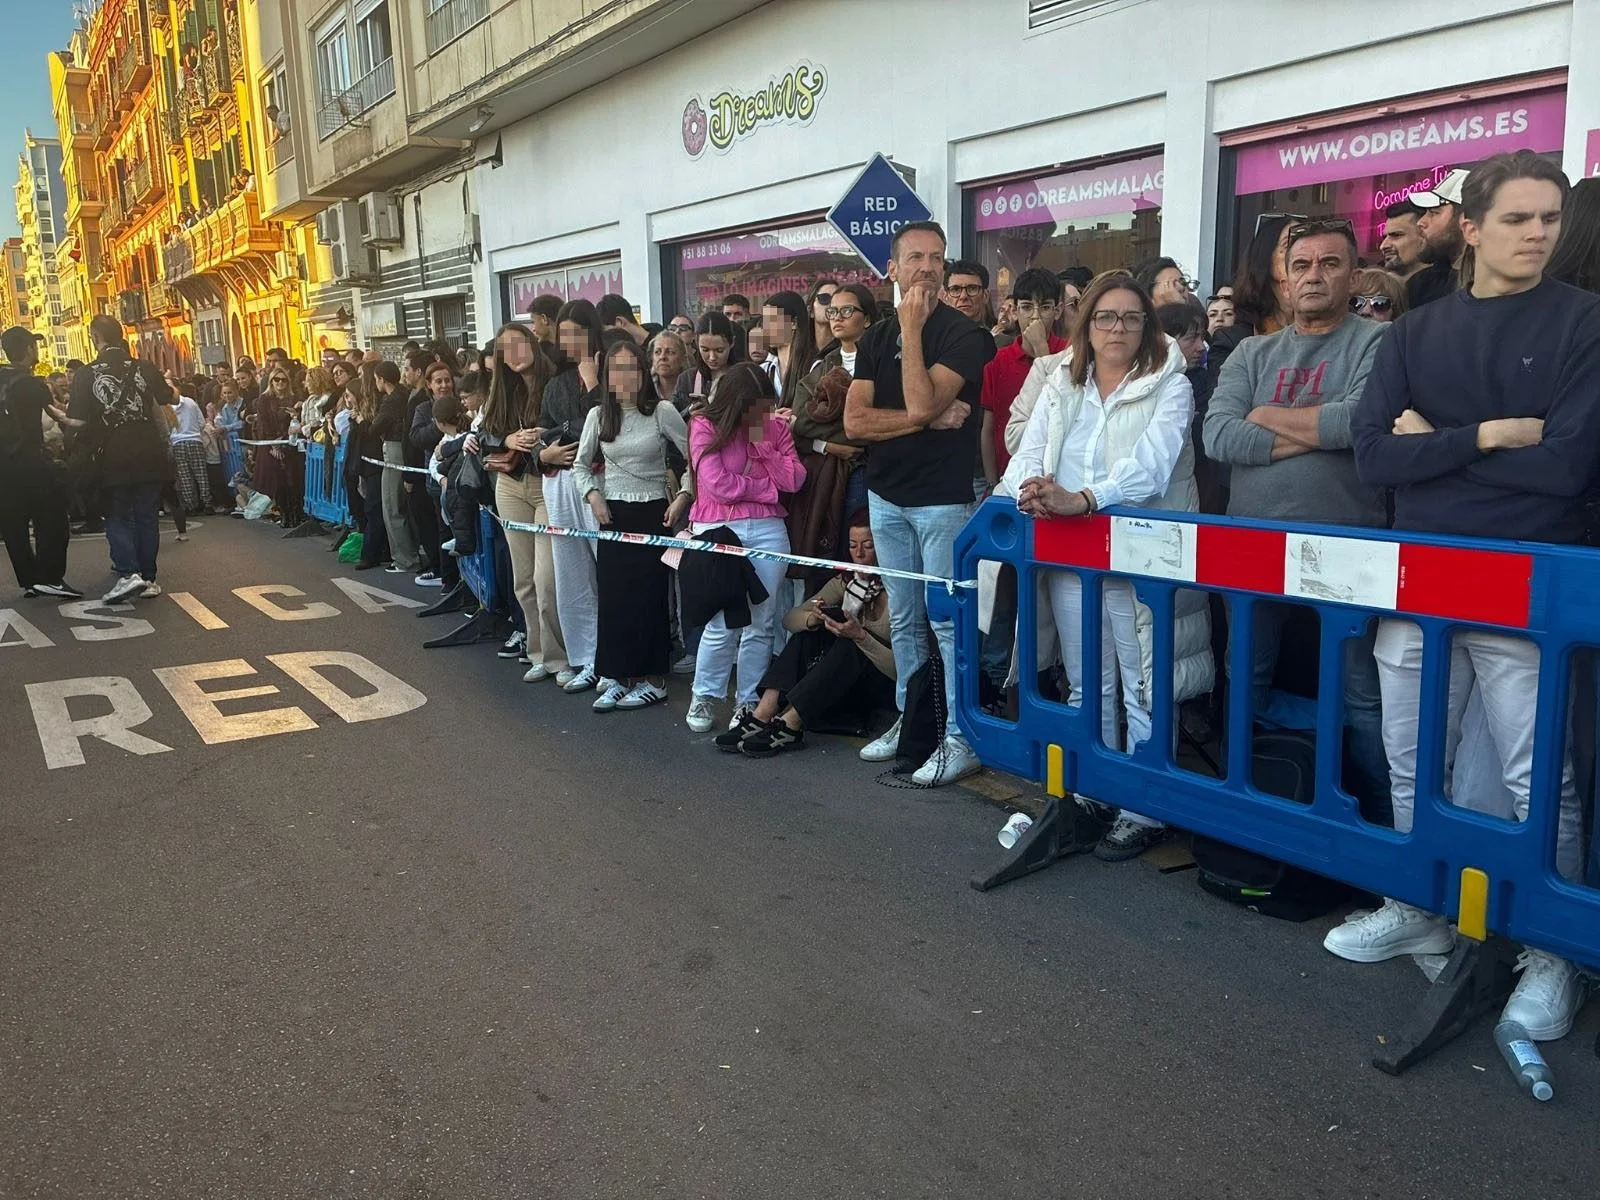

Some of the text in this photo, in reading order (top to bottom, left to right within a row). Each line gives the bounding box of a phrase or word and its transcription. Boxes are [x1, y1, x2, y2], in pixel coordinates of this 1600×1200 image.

[1279, 109, 1529, 169] WWW.ODREAMS.ES
[864, 196, 897, 212] RED
[1374, 178, 1431, 210] Compone
[849, 216, 910, 236] BÁSIC
[682, 242, 731, 260] 951 88 33 06
[24, 650, 428, 770] RED
